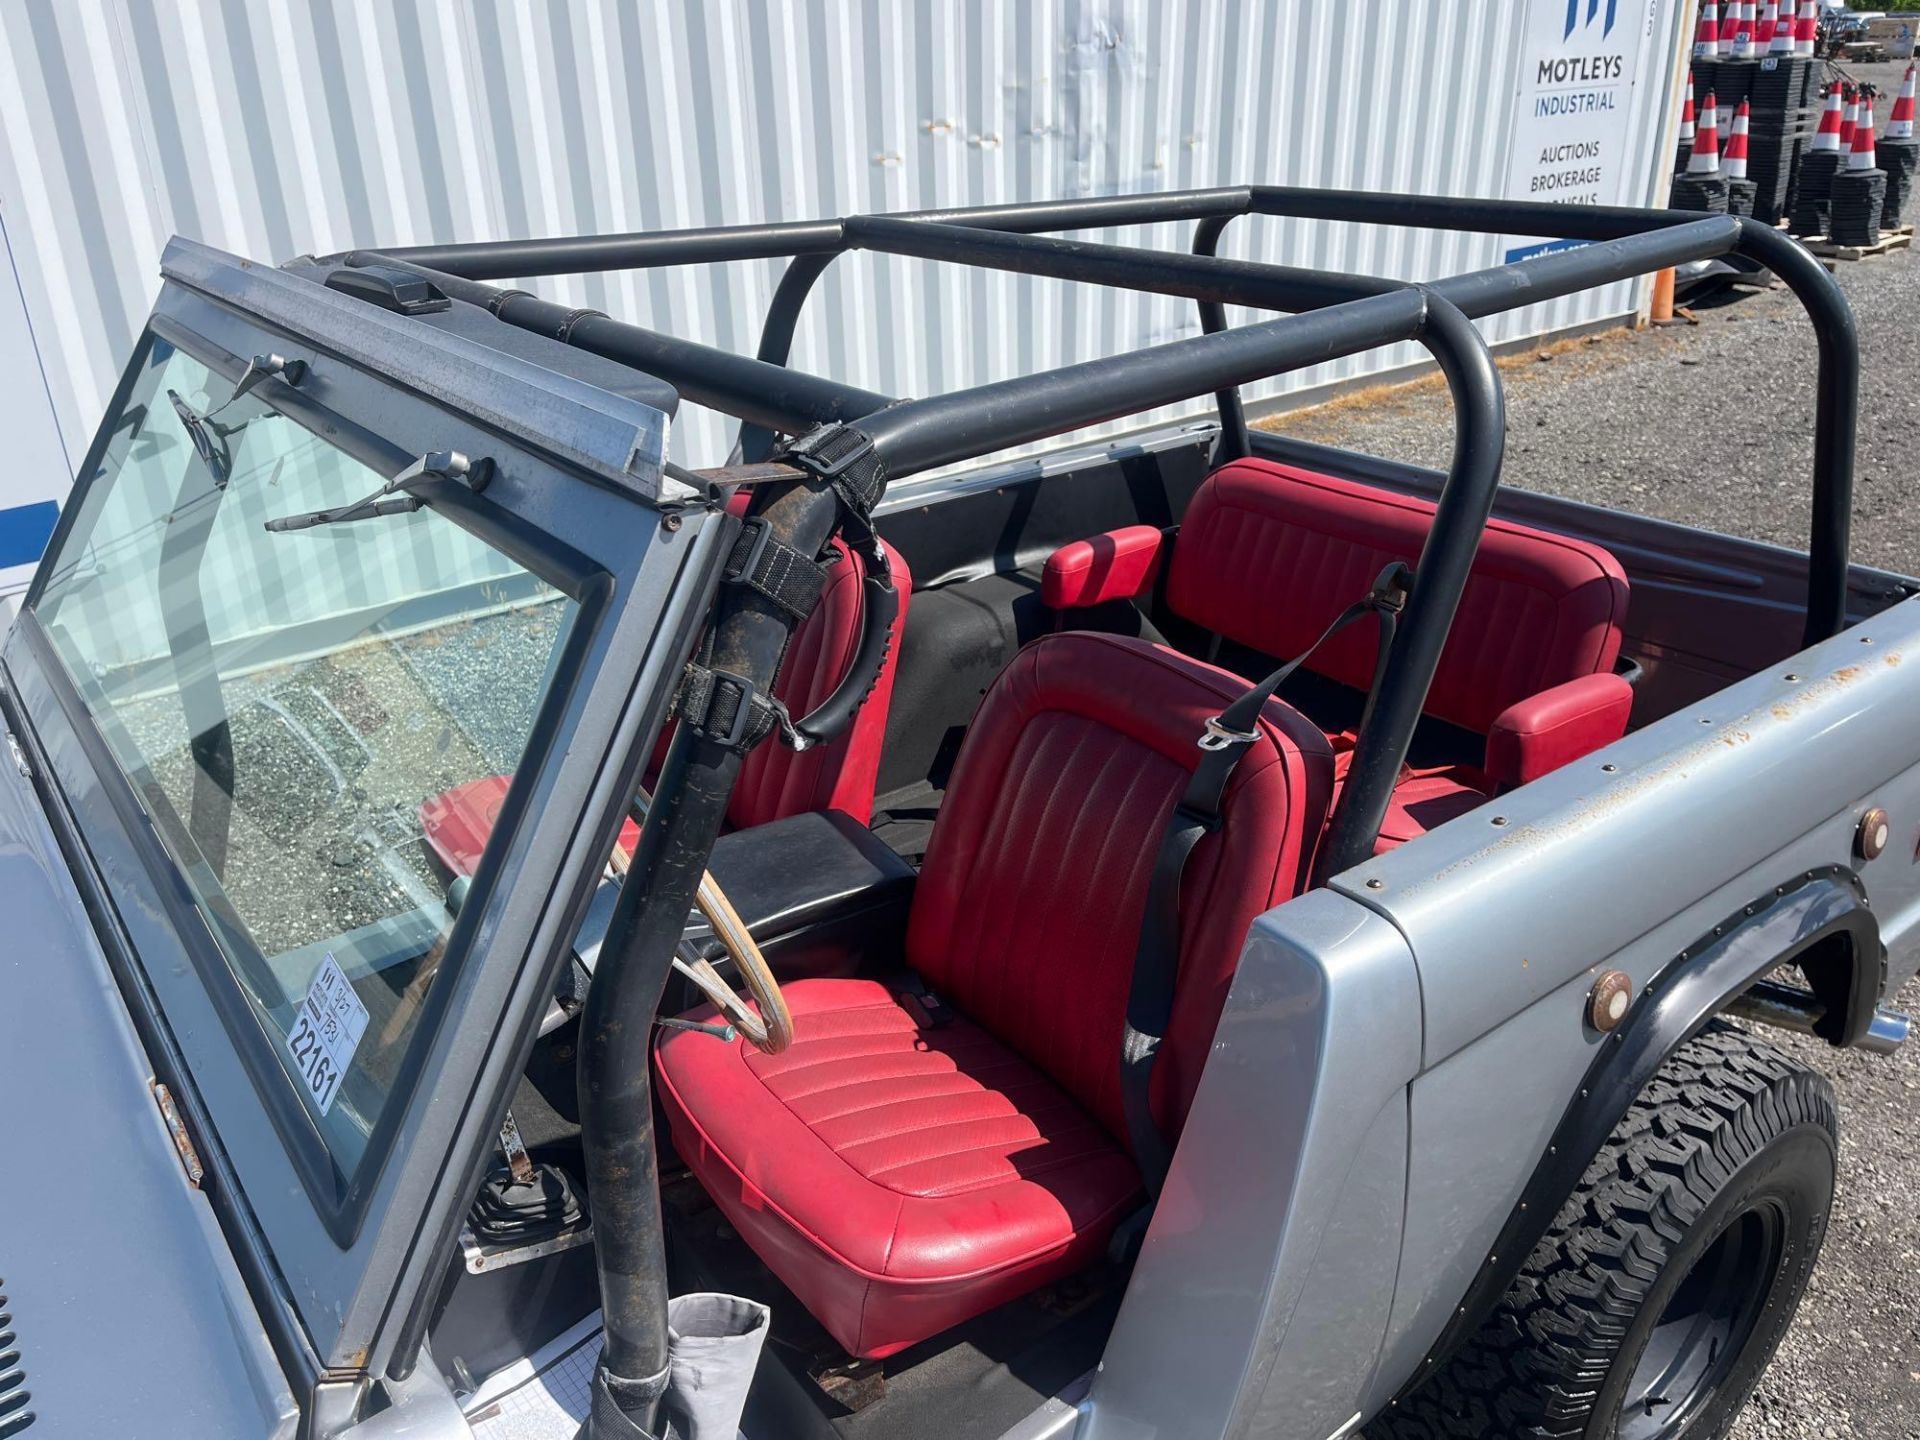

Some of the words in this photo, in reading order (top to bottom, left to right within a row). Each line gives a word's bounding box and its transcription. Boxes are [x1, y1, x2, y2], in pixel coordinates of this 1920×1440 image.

[1537, 55, 1622, 84] MOTLEYS
[1535, 91, 1615, 117] INDUSTRIAL
[1539, 141, 1600, 164] AUCTIONS
[1531, 167, 1601, 192] BROKERAGE
[290, 1017, 338, 1106] 22161
